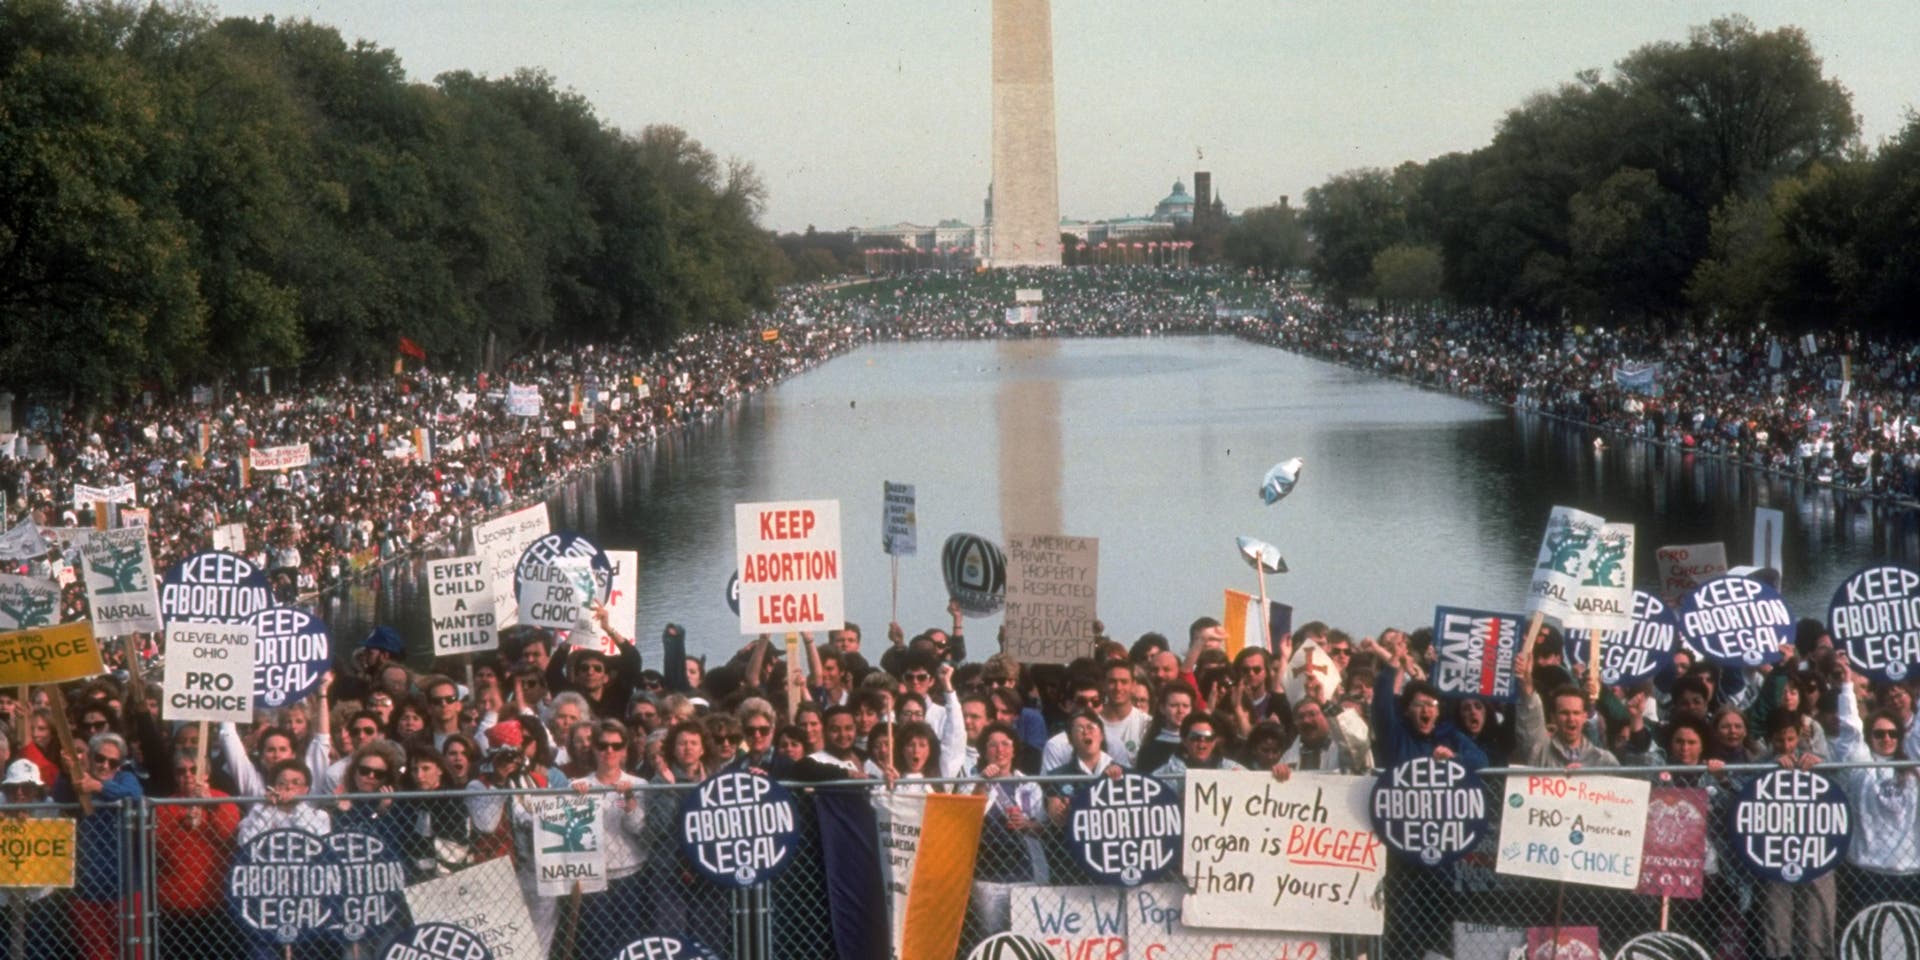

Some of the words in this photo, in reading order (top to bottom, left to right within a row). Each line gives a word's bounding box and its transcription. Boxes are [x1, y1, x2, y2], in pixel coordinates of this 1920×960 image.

[475, 524, 516, 545] George
[759, 509, 816, 541] KEEP
[1012, 551, 1065, 565] PRIVATE
[1031, 536, 1088, 550] AMERICA
[182, 553, 252, 584] KEEP
[433, 561, 482, 580] EVERY
[743, 550, 837, 583] ABORTION
[1022, 566, 1088, 581] PROPERTY
[162, 584, 267, 616] ABORTION
[433, 580, 485, 596] CHILD
[546, 585, 574, 603] FOR
[1023, 580, 1095, 598] RESPECTED
[1694, 577, 1762, 608] KEEP
[1847, 566, 1920, 603] KEEP
[97, 603, 151, 620] NARAL
[454, 598, 467, 611] A
[758, 593, 825, 625] LEGAL
[1006, 602, 1021, 615] MY
[1027, 602, 1088, 618] UTERUS
[1684, 599, 1790, 638] ABORTION
[432, 613, 495, 631] WANTED
[1020, 616, 1095, 638] PRIVATE
[17, 634, 44, 644] PRO
[173, 631, 249, 646] CLEVELAND
[193, 647, 229, 660] OHIO
[254, 633, 328, 665] ORTION
[438, 630, 490, 648] CHILD
[1006, 636, 1094, 659] PROPERTY
[1438, 613, 1472, 692] LIVES
[1701, 626, 1787, 659] LEGAL
[1847, 632, 1920, 669] LEGA
[1493, 618, 1516, 697] MOBILIZE
[186, 672, 234, 692] PRO
[253, 663, 318, 696] EGAL
[171, 693, 247, 711] CHOICE
[1393, 756, 1466, 788] KEEP
[1756, 768, 1830, 800] KEEP
[700, 773, 771, 808] KEEP
[1089, 773, 1161, 807] KEEP
[1194, 781, 1233, 827] My
[1245, 783, 1328, 824] church
[1375, 788, 1485, 819] ABORTION
[685, 801, 794, 843] ABORTION
[1073, 804, 1182, 842] ABORTION
[1737, 801, 1848, 835] ABORTION
[250, 832, 323, 863] KEEP
[329, 833, 384, 863] EEP
[1191, 833, 1250, 863] organ
[1260, 827, 1282, 856] is
[1286, 824, 1383, 867] BIGGER
[1386, 820, 1476, 852] LEGAL
[1746, 835, 1838, 868] LEGAL
[541, 863, 599, 879] NARAL
[698, 836, 786, 874] LEGAL
[1085, 839, 1174, 874] LEGAL
[1643, 854, 1700, 868] ERMONT
[231, 864, 342, 897] ABORTION
[1190, 860, 1255, 894] than
[1273, 871, 1360, 907] yours!
[242, 897, 332, 929] LEGAL
[1032, 895, 1081, 935] We
[412, 926, 485, 960] KEEP
